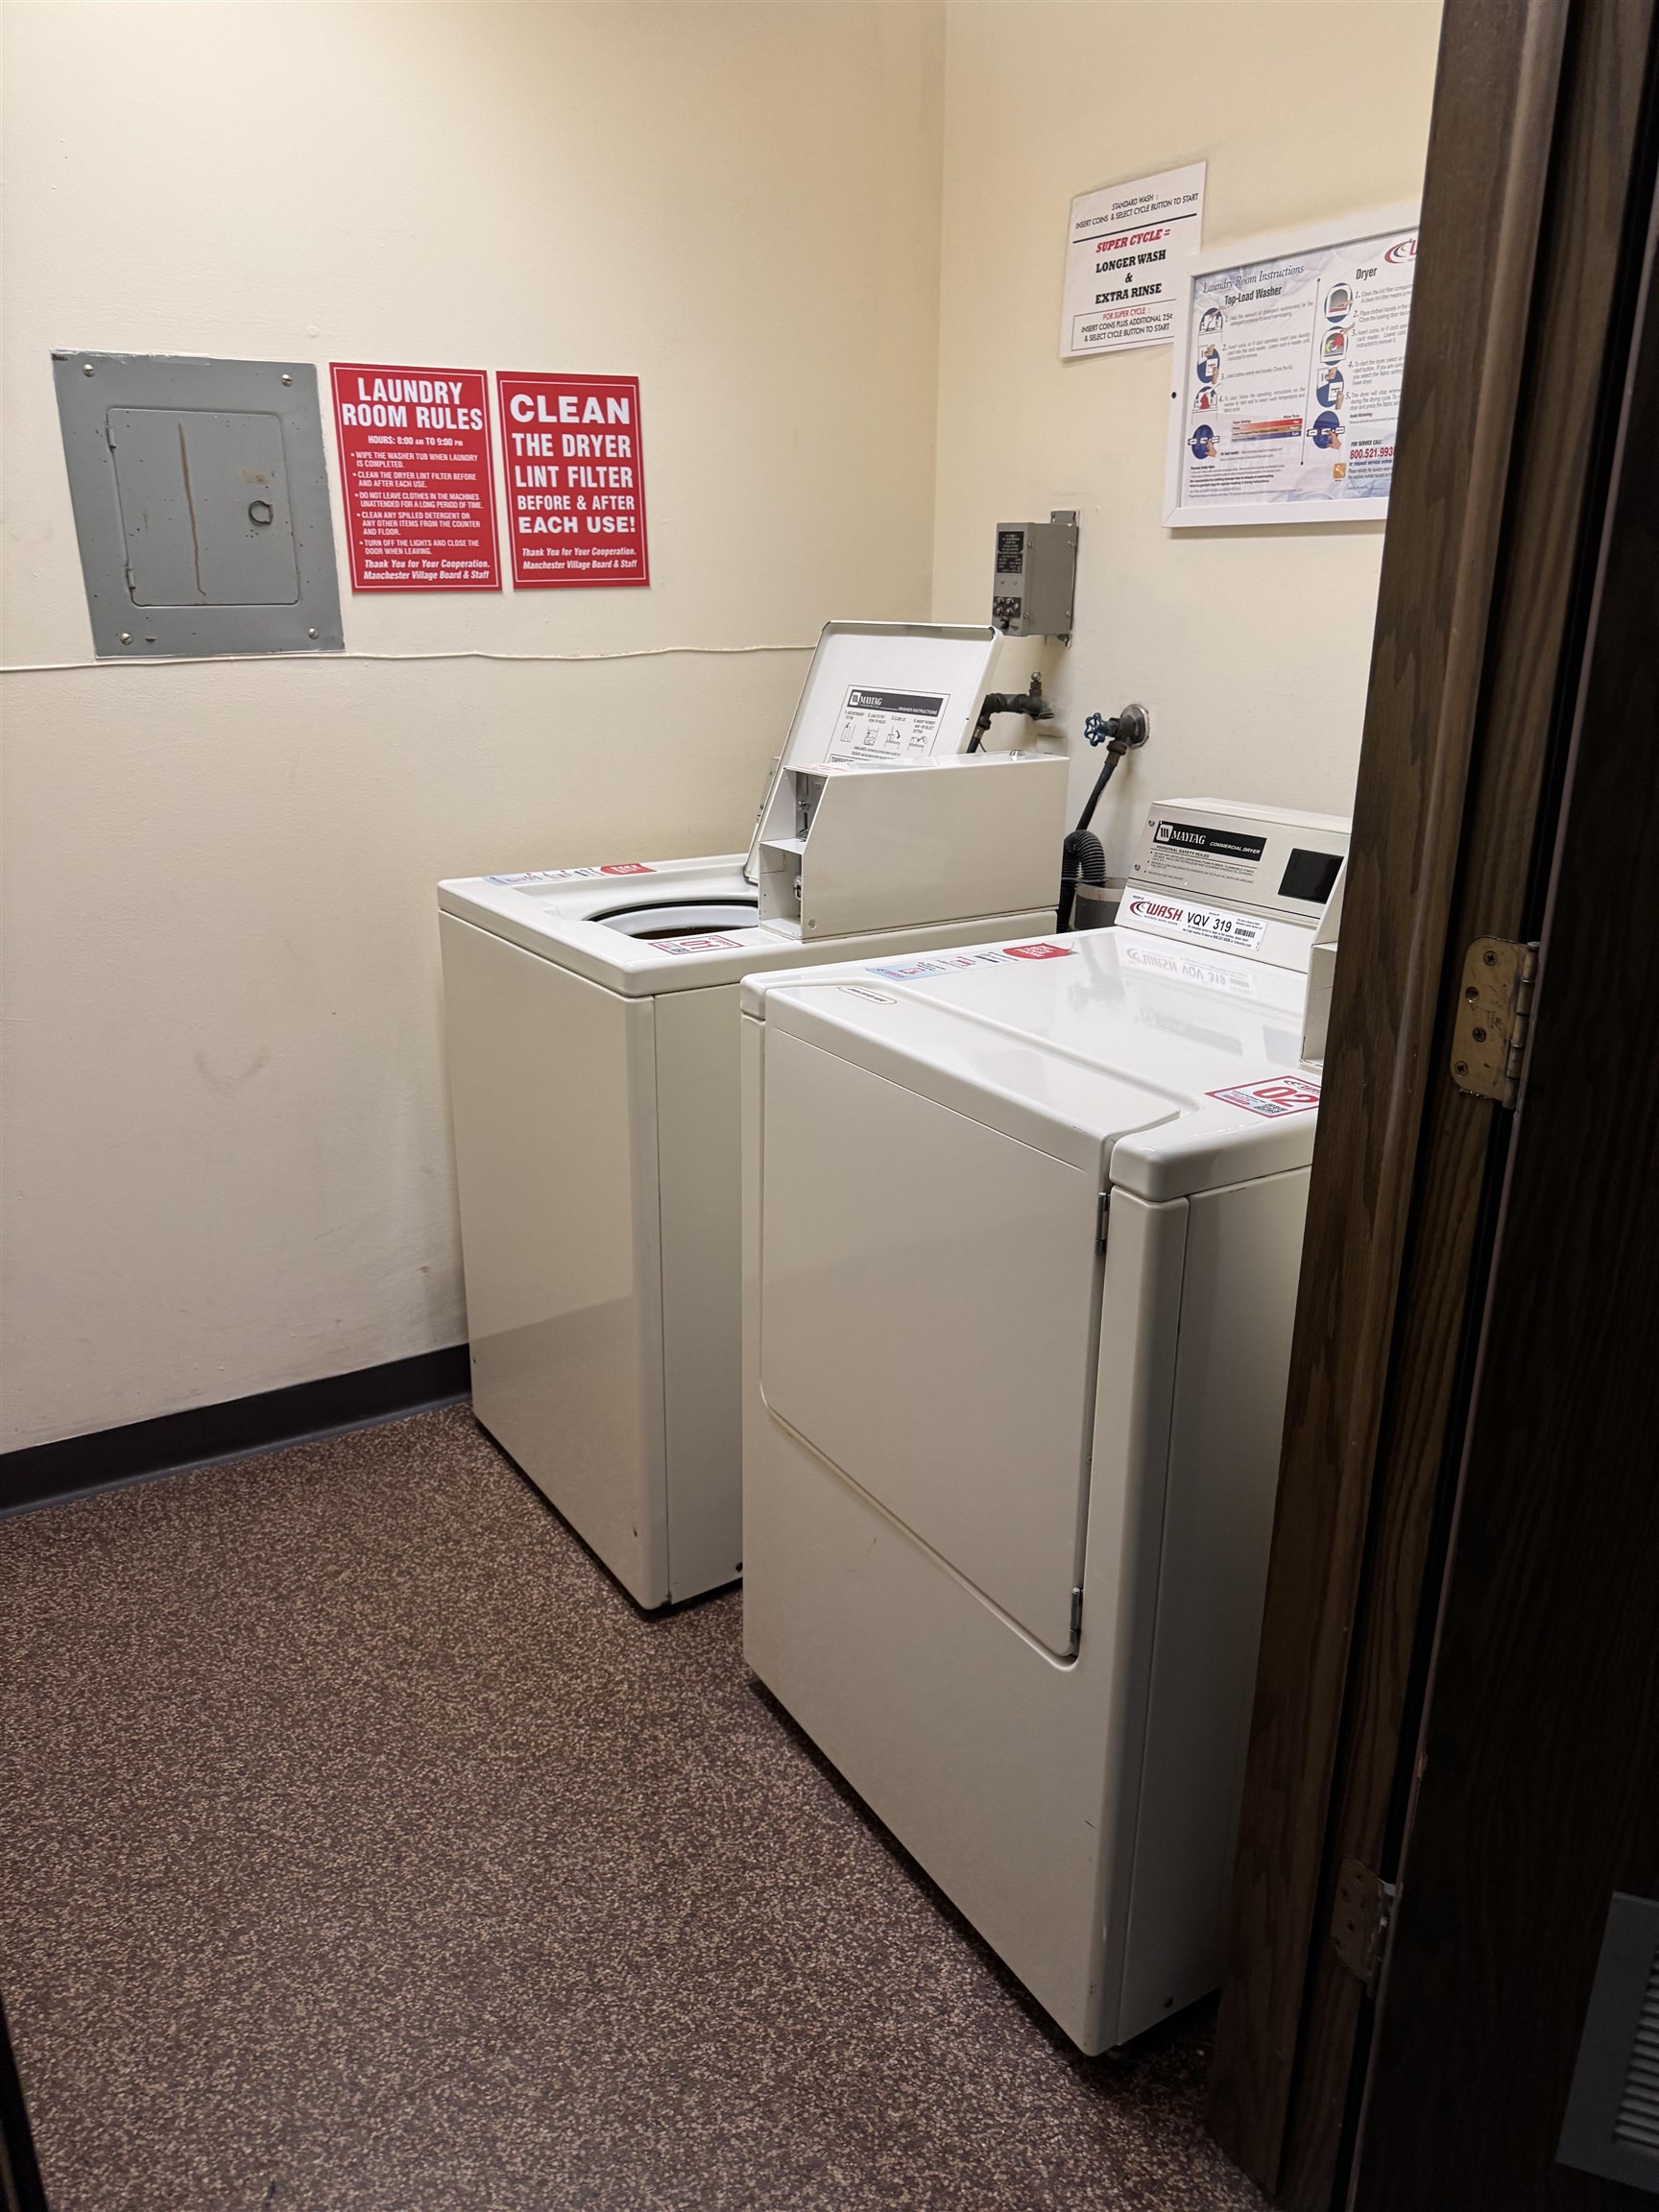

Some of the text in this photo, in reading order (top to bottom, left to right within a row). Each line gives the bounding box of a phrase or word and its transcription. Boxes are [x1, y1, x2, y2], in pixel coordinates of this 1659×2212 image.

[1075, 219, 1092, 228] INSERT
[1092, 215, 1109, 225] COINS
[1116, 208, 1133, 219] SELECT
[1134, 204, 1149, 215] CYCLE
[1150, 200, 1172, 211] BUTTON
[1173, 197, 1181, 205] TO
[1182, 193, 1198, 204] START
[1112, 194, 1153, 210] STANDARD WASH
[1096, 237, 1129, 252] SUPER
[1130, 228, 1163, 246] CYCLE
[1095, 250, 1166, 274] LONGER WASH
[1125, 273, 1132, 283] &
[1203, 265, 1304, 293] Laundry Room Instructions
[1356, 268, 1378, 280] Dryer
[1095, 283, 1162, 304] EXTRA RINSE
[1225, 286, 1282, 306] Top-Load Washer
[1114, 310, 1129, 319] SUPER
[1081, 325, 1098, 333] INSERT
[1099, 322, 1115, 330] COINS
[1117, 319, 1128, 327] PLUS
[1129, 315, 1162, 326] ADDITIONAL
[1089, 332, 1106, 341] SELECT
[1107, 330, 1122, 339] CYCLE
[1123, 327, 1144, 336] BUTTON
[357, 377, 463, 405] LAUNDRY
[342, 403, 483, 430] ROOM RULES
[510, 394, 631, 424] CLEAN
[512, 433, 632, 457] THE DRYER
[515, 466, 634, 488] LINT FILTER
[517, 495, 635, 510] BEFORE & AFTER
[518, 517, 636, 533] EACH USE!
[591, 547, 637, 557] Cooperation.
[441, 560, 490, 569] Cooperation.
[523, 561, 565, 569] Manchester
[566, 561, 590, 570] Village
[412, 571, 437, 581] Village
[859, 696, 882, 706] MAYTAG
[1172, 830, 1206, 844] MAYTAG
[1210, 841, 1241, 851] COMMERCIAL
[1146, 902, 1184, 922] WASH
[1188, 912, 1210, 926] VQV
[1214, 919, 1232, 932] 319
[1253, 1087, 1319, 1107] 02
